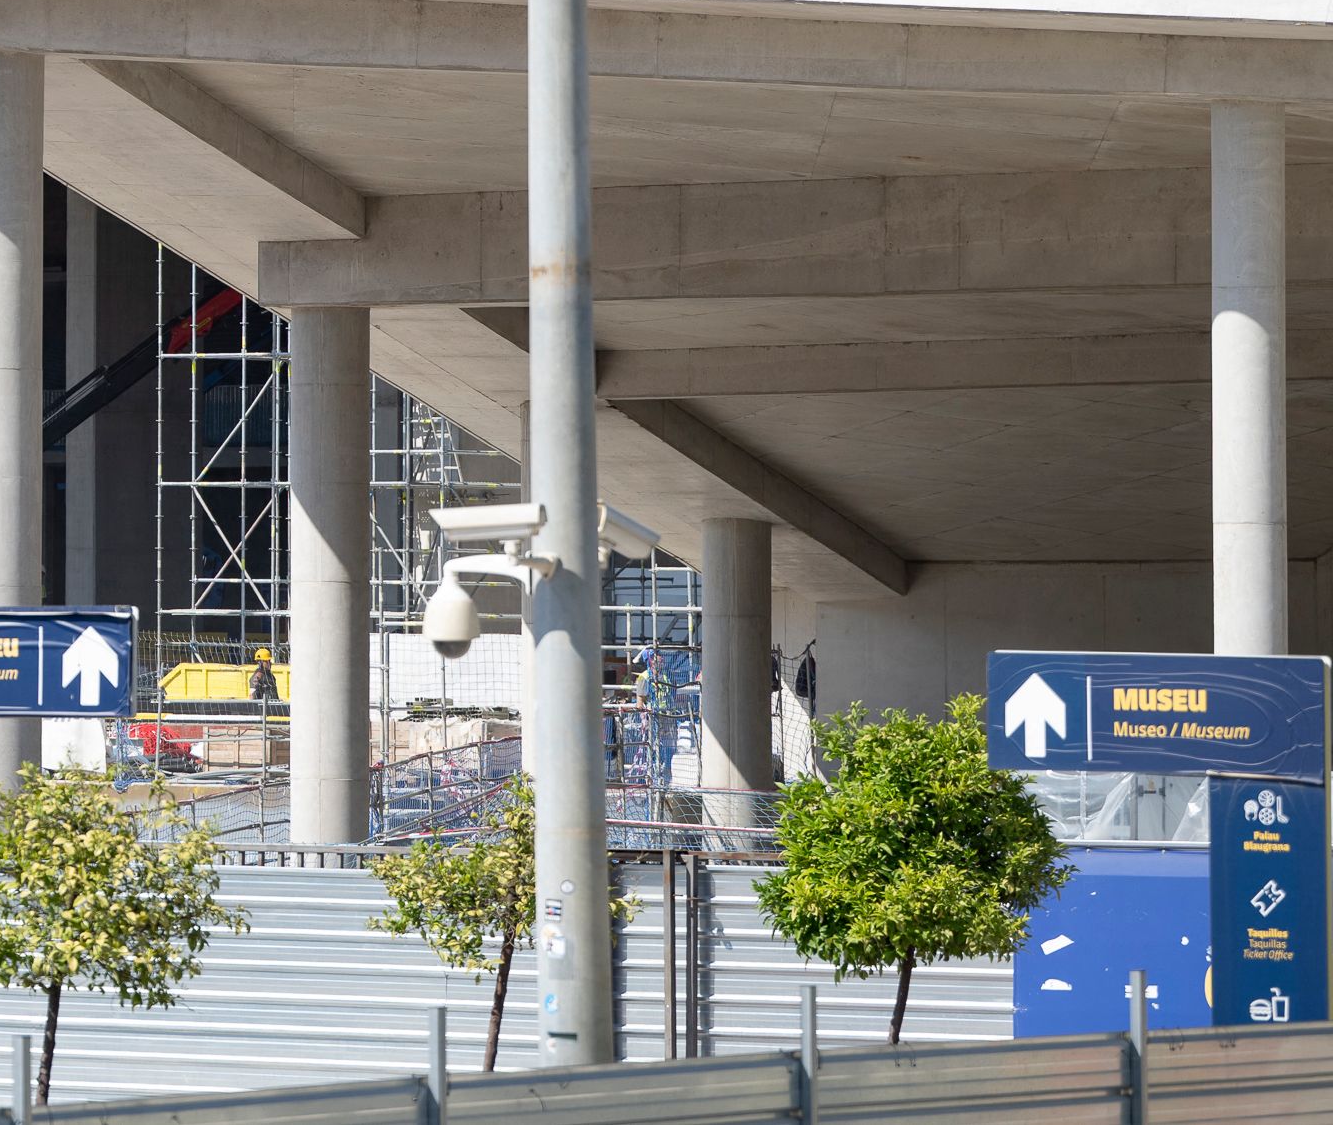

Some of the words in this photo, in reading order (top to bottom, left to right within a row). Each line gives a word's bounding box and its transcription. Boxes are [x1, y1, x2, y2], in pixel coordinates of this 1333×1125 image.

[1113, 687, 1207, 713] MUSEU
[1113, 721, 1167, 737] Museo
[1181, 722, 1251, 740] Museum
[1253, 831, 1281, 841] Palau
[1243, 841, 1291, 853] Blaugrana
[1247, 928, 1289, 939] Taquilles
[1249, 939, 1287, 949] Taquillas
[1243, 949, 1267, 959] Ticket
[1268, 949, 1293, 961] Office
